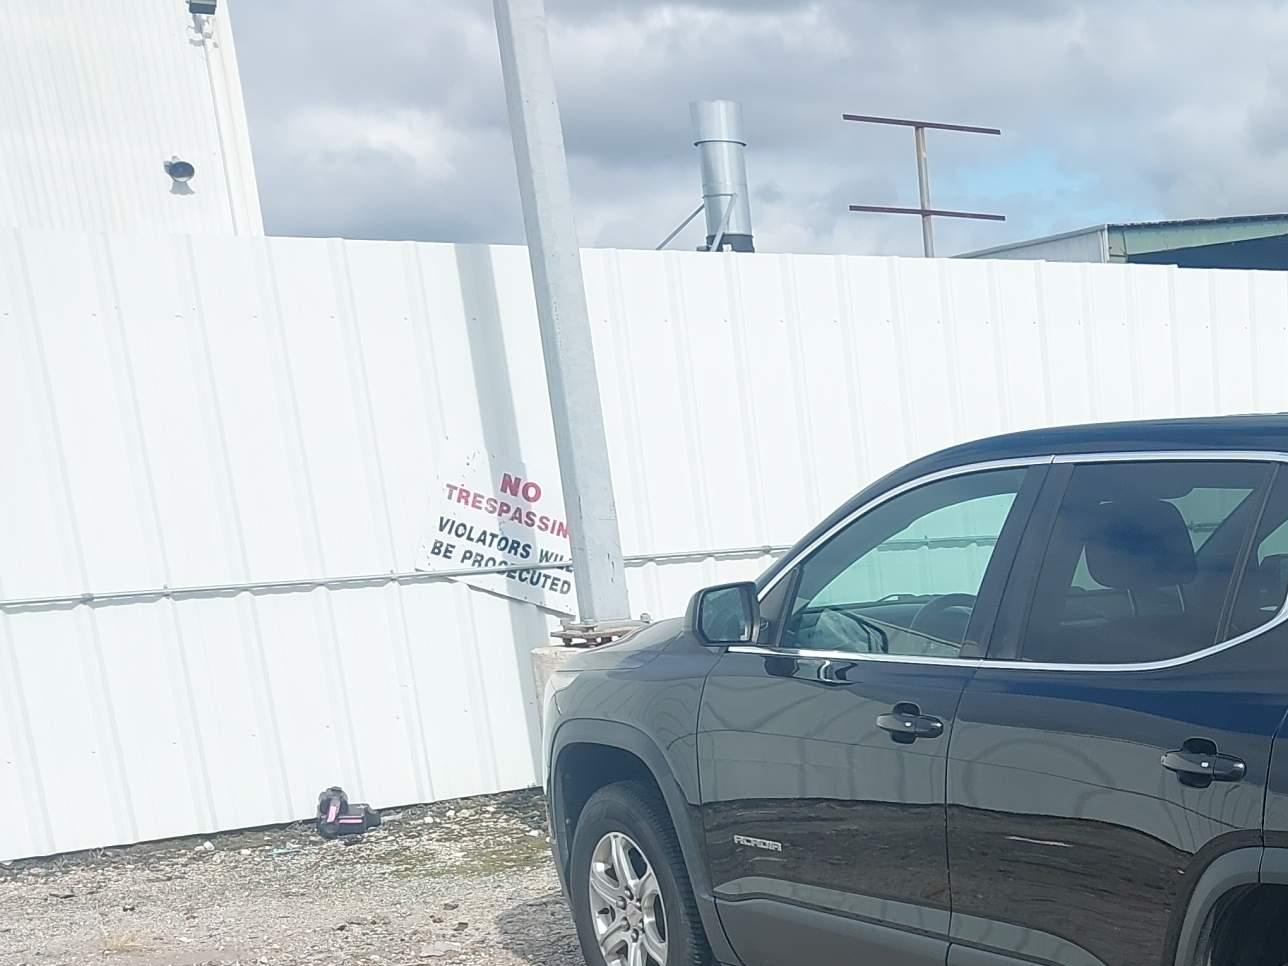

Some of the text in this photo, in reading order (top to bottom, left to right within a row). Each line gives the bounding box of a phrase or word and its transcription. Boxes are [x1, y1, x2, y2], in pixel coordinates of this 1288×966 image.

[500, 473, 542, 503] NO
[446, 484, 570, 539] TRESPASSIN
[430, 539, 456, 560] BE
[438, 516, 532, 559] VIOLATORS
[733, 834, 782, 852] ACADIA
